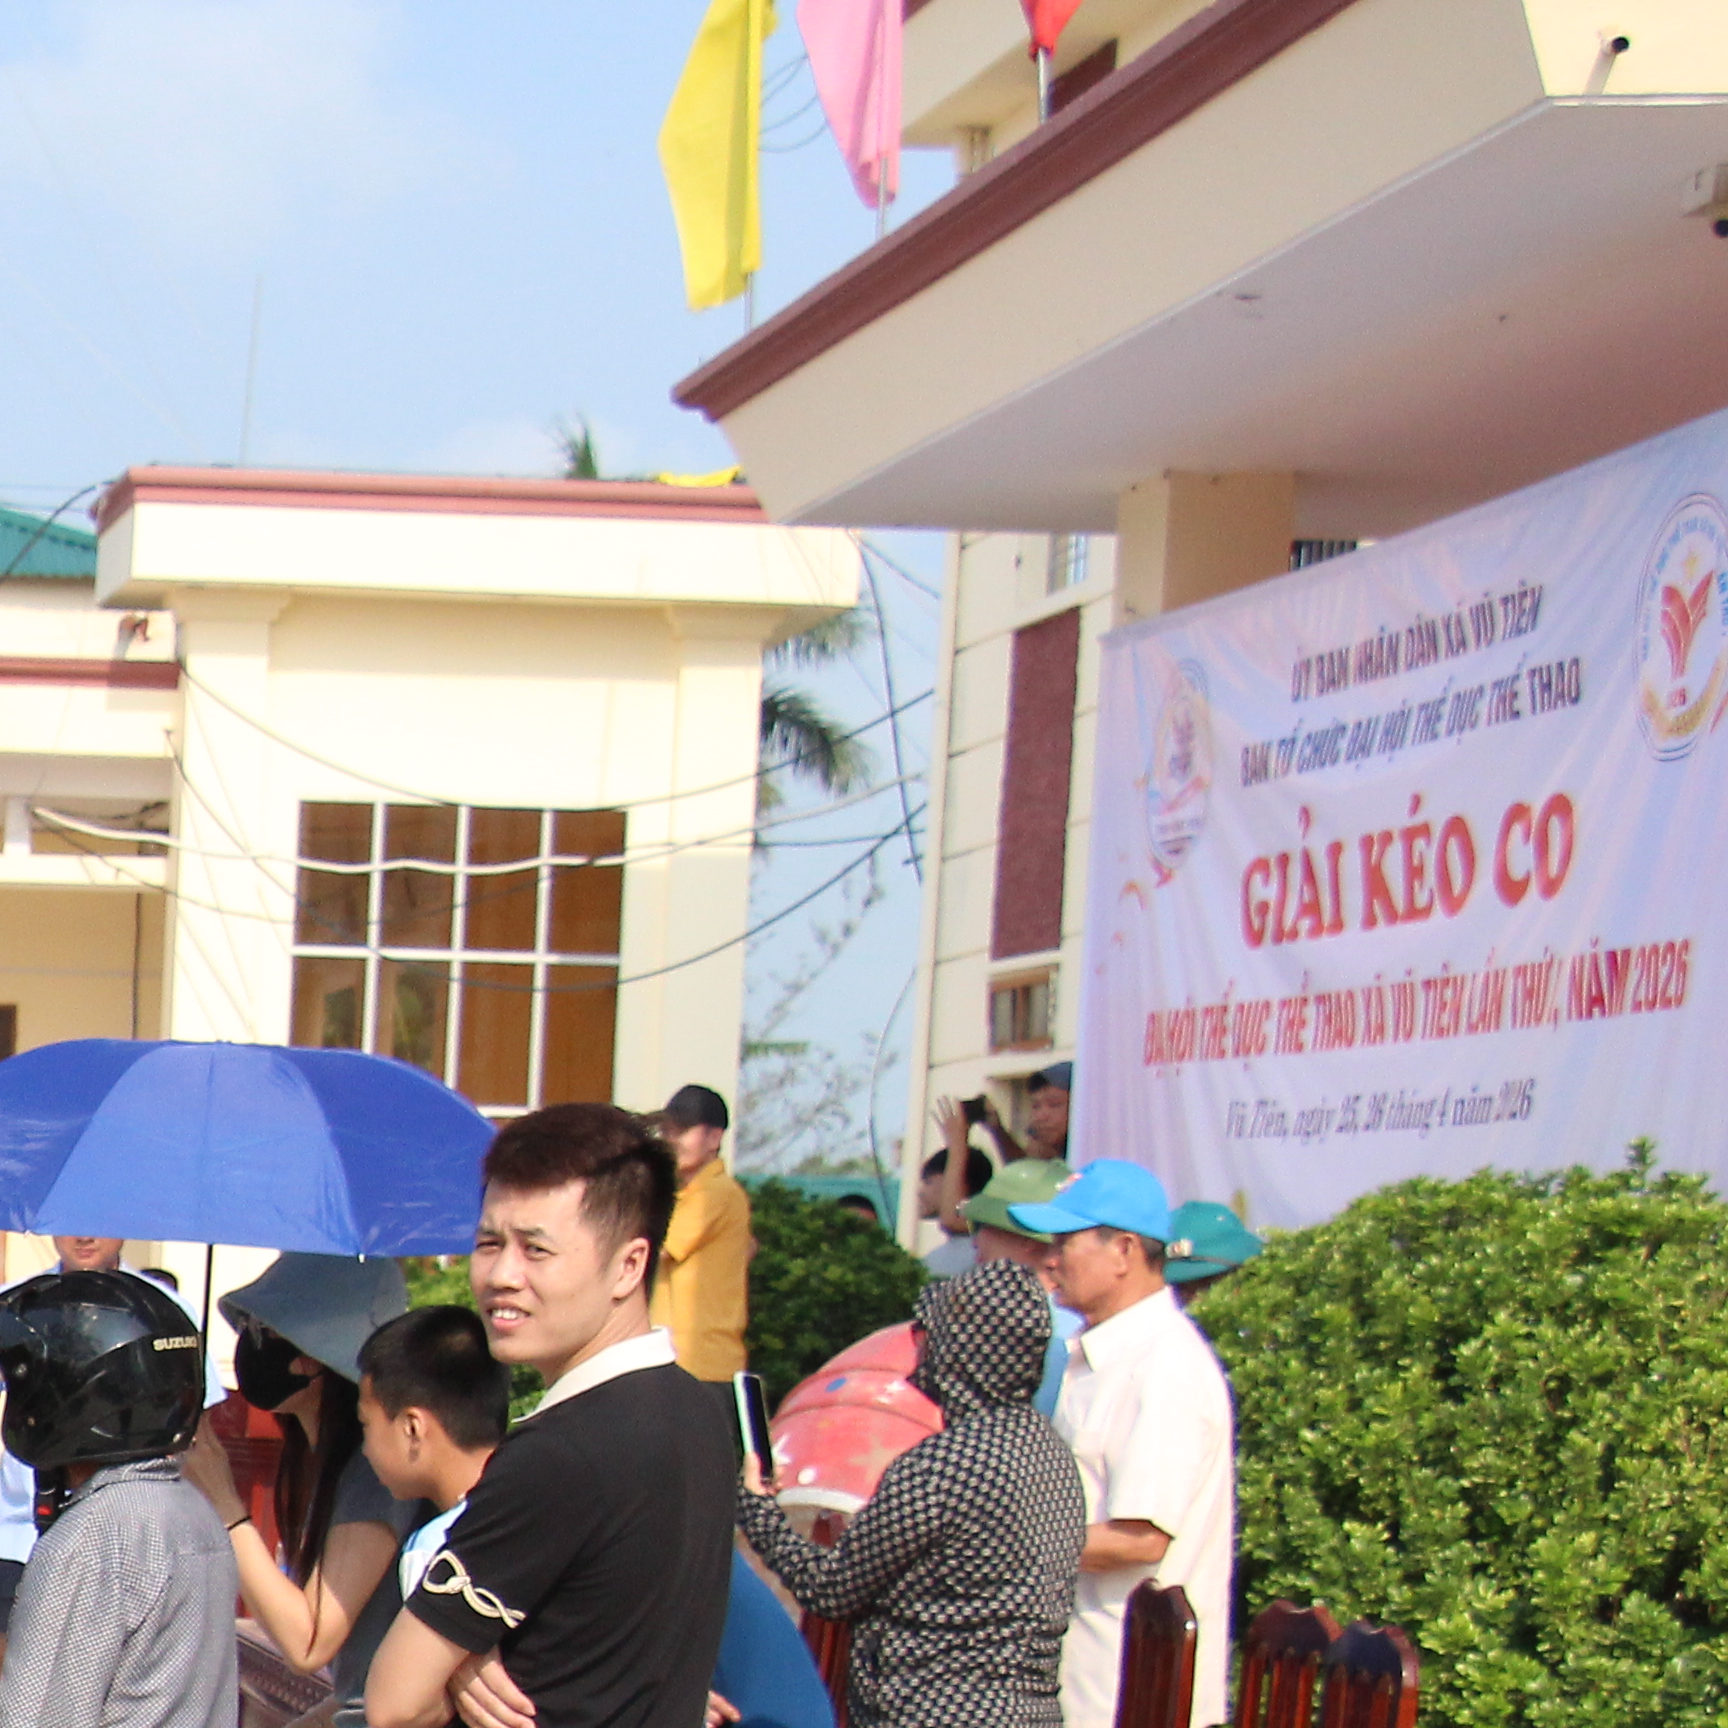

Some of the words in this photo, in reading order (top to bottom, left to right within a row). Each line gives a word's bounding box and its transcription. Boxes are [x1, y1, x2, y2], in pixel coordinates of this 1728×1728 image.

[1315, 647, 1350, 697] BAN
[1526, 656, 1582, 715] THAO
[1241, 803, 1344, 950] GIẢI
[1360, 793, 1477, 930] KÉO
[1493, 793, 1576, 908] CO
[1567, 937, 1632, 1022] NĂM
[1630, 938, 1691, 1013] 2026
[1451, 1083, 1495, 1127] năm
